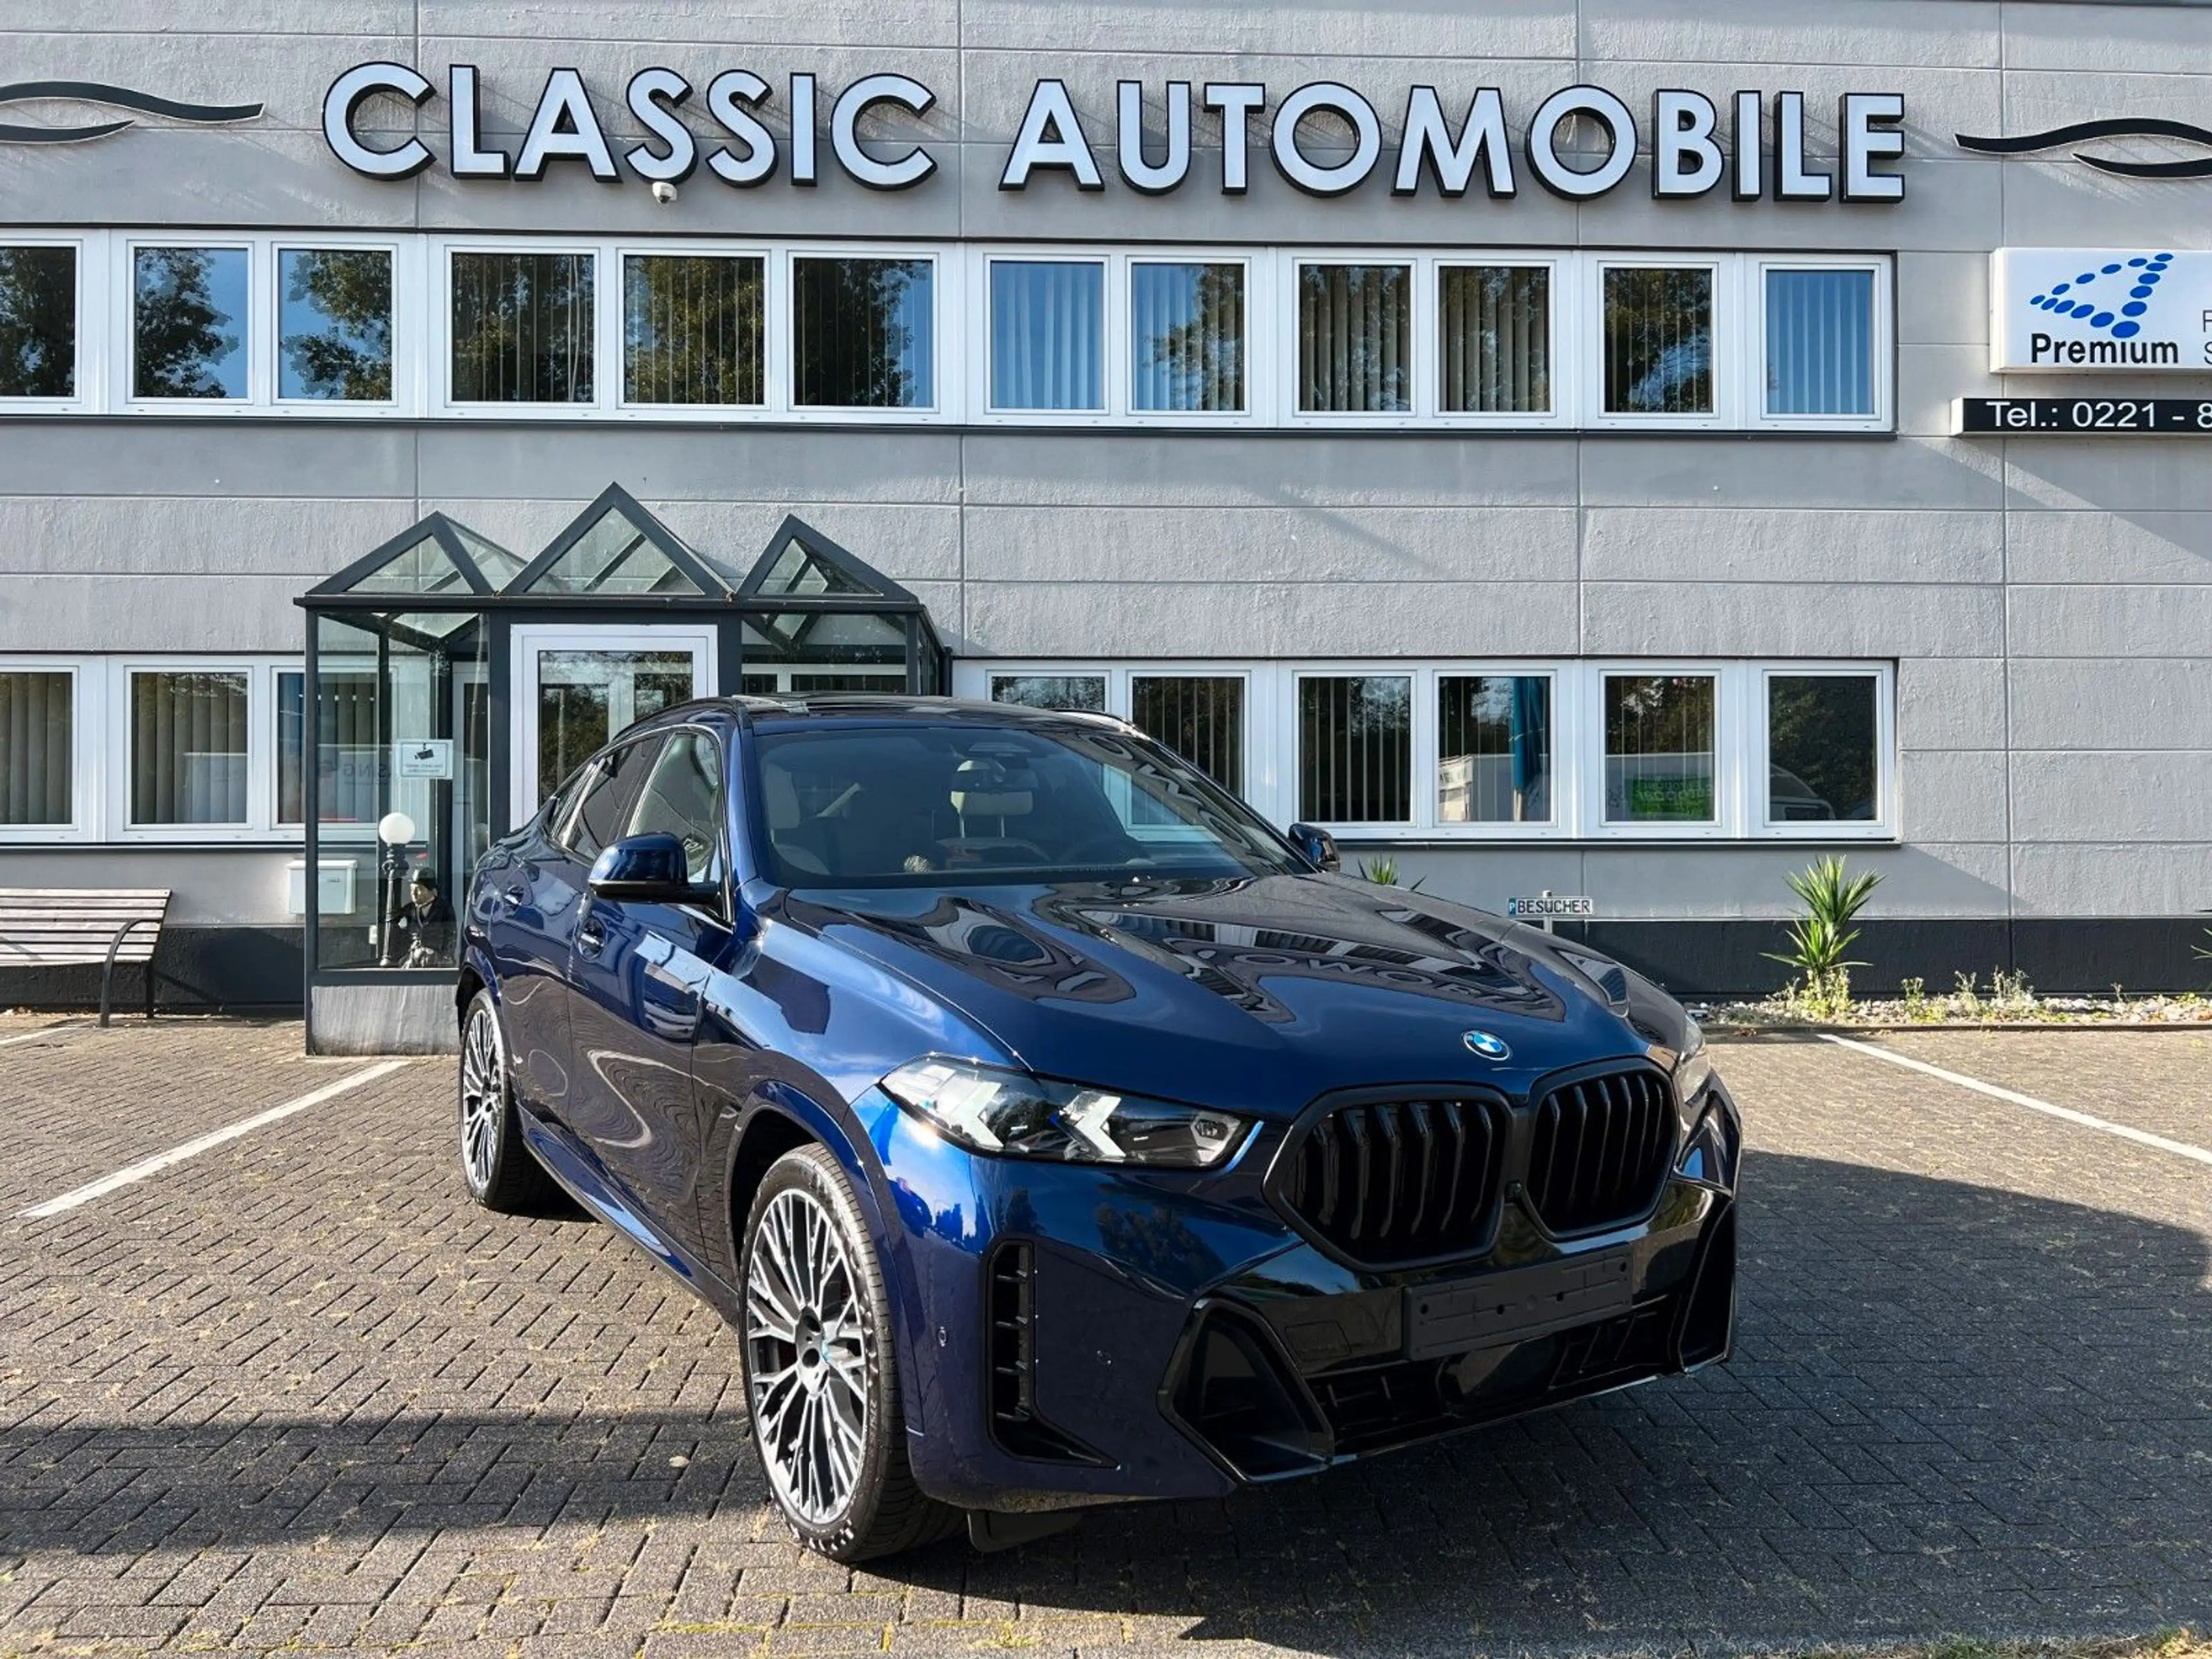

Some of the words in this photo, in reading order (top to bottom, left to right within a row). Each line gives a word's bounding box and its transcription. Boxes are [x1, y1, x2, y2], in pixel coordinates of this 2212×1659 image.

[321, 60, 937, 191] CLASSIC
[998, 78, 1906, 204] AUTOMOBILE
[2031, 333, 2179, 364] Premium
[1986, 402, 2058, 427] Tel.:
[2073, 402, 2154, 427] 0221
[1517, 900, 1591, 914] BESUCHER
